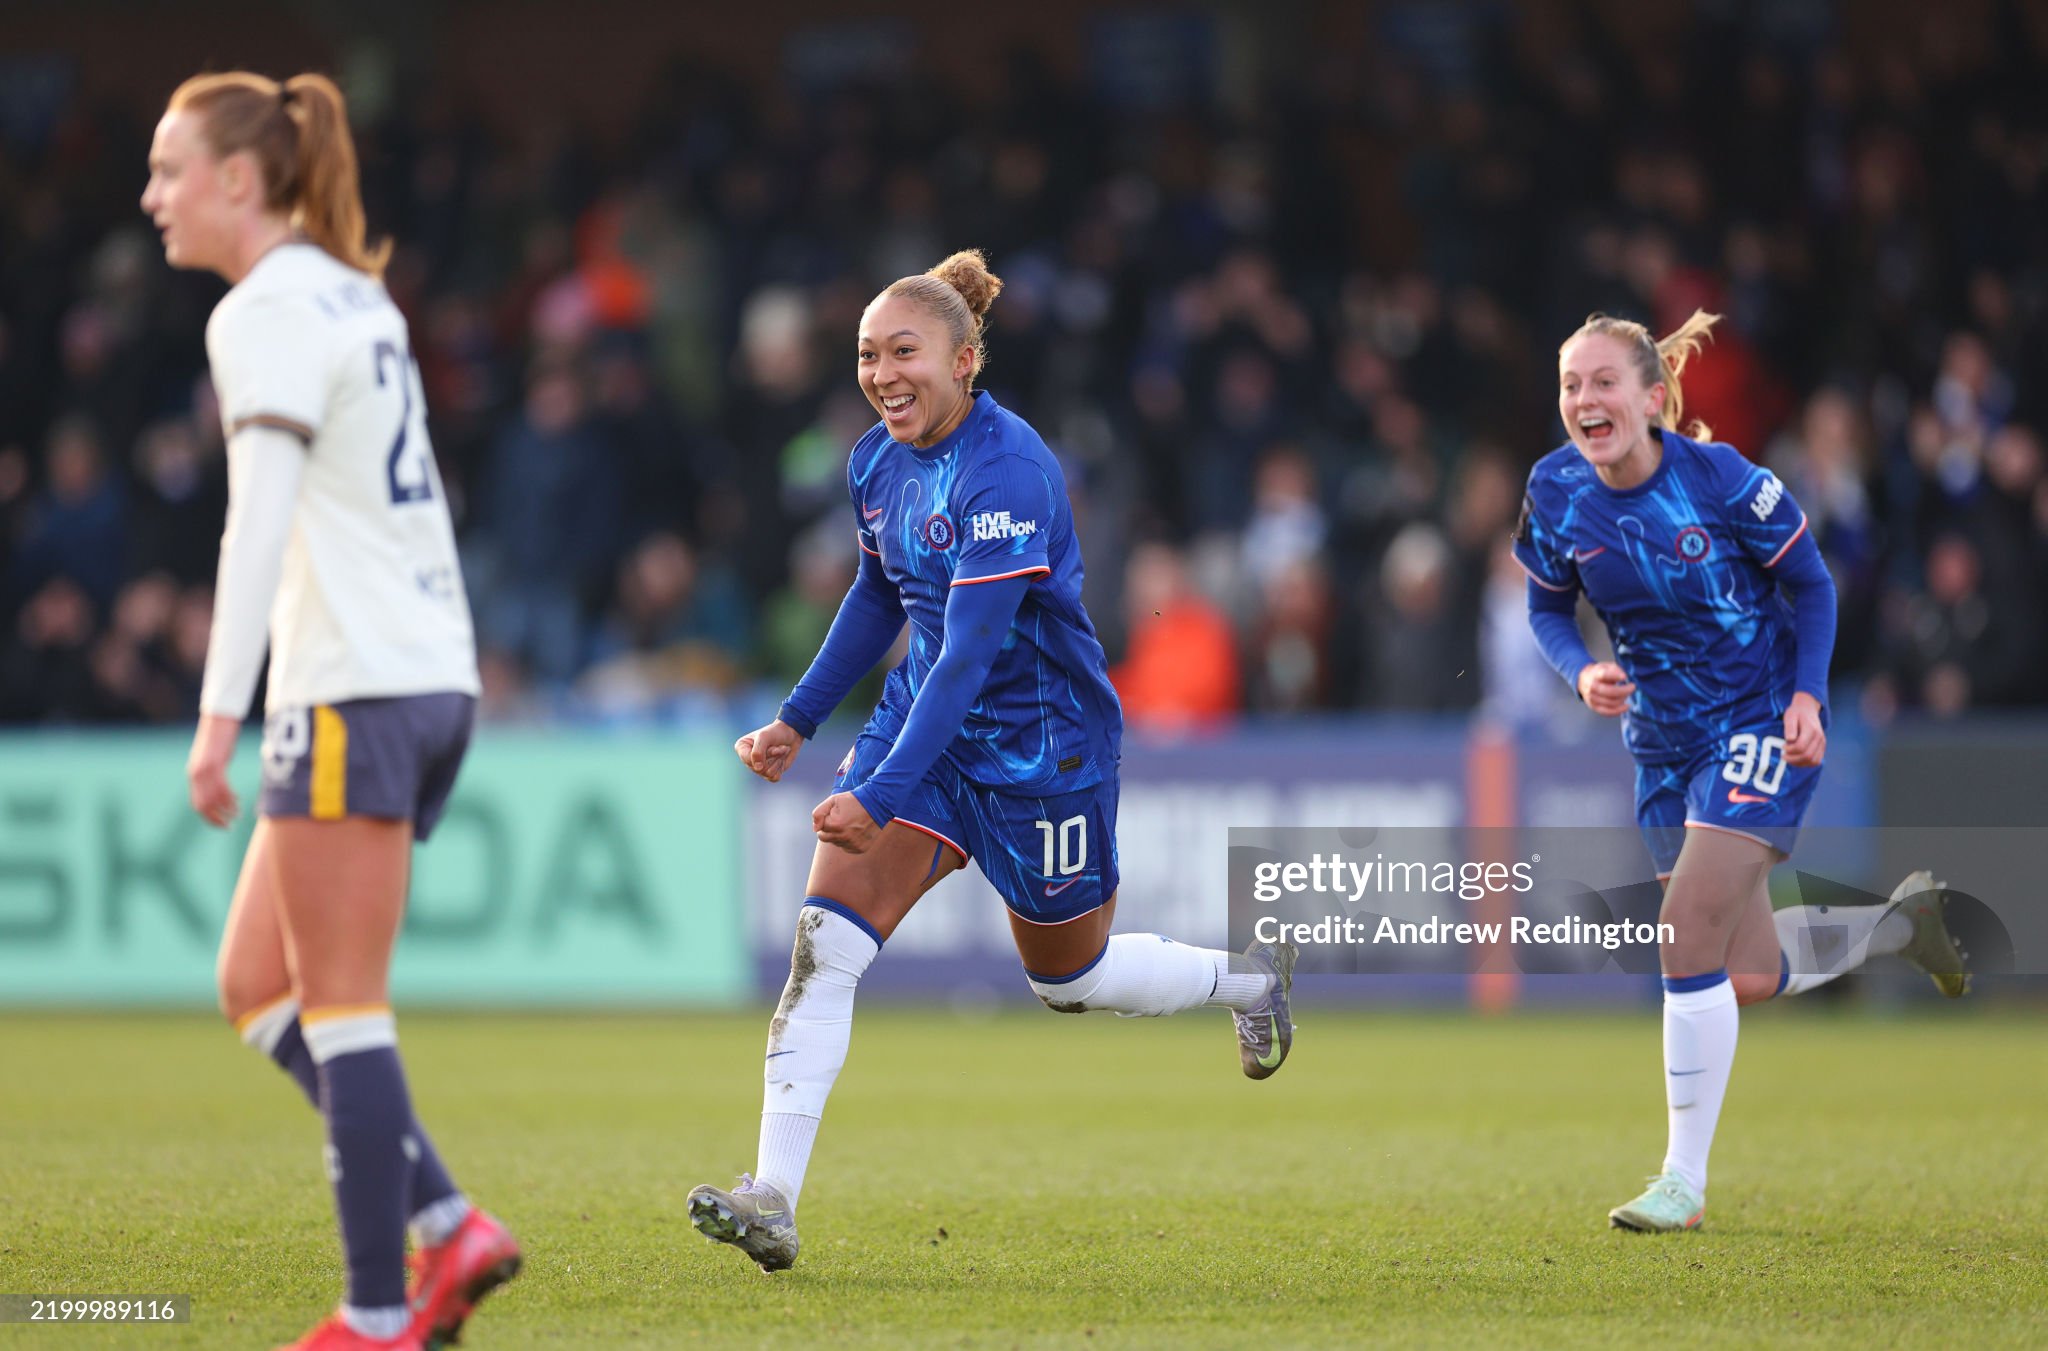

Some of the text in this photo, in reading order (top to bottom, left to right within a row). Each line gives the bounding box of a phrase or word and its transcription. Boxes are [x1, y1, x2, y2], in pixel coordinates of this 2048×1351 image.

[973, 511, 1010, 527] LIVE
[973, 520, 1036, 541] NATION
[1722, 733, 1787, 795] 30
[1035, 814, 1087, 877] 10
